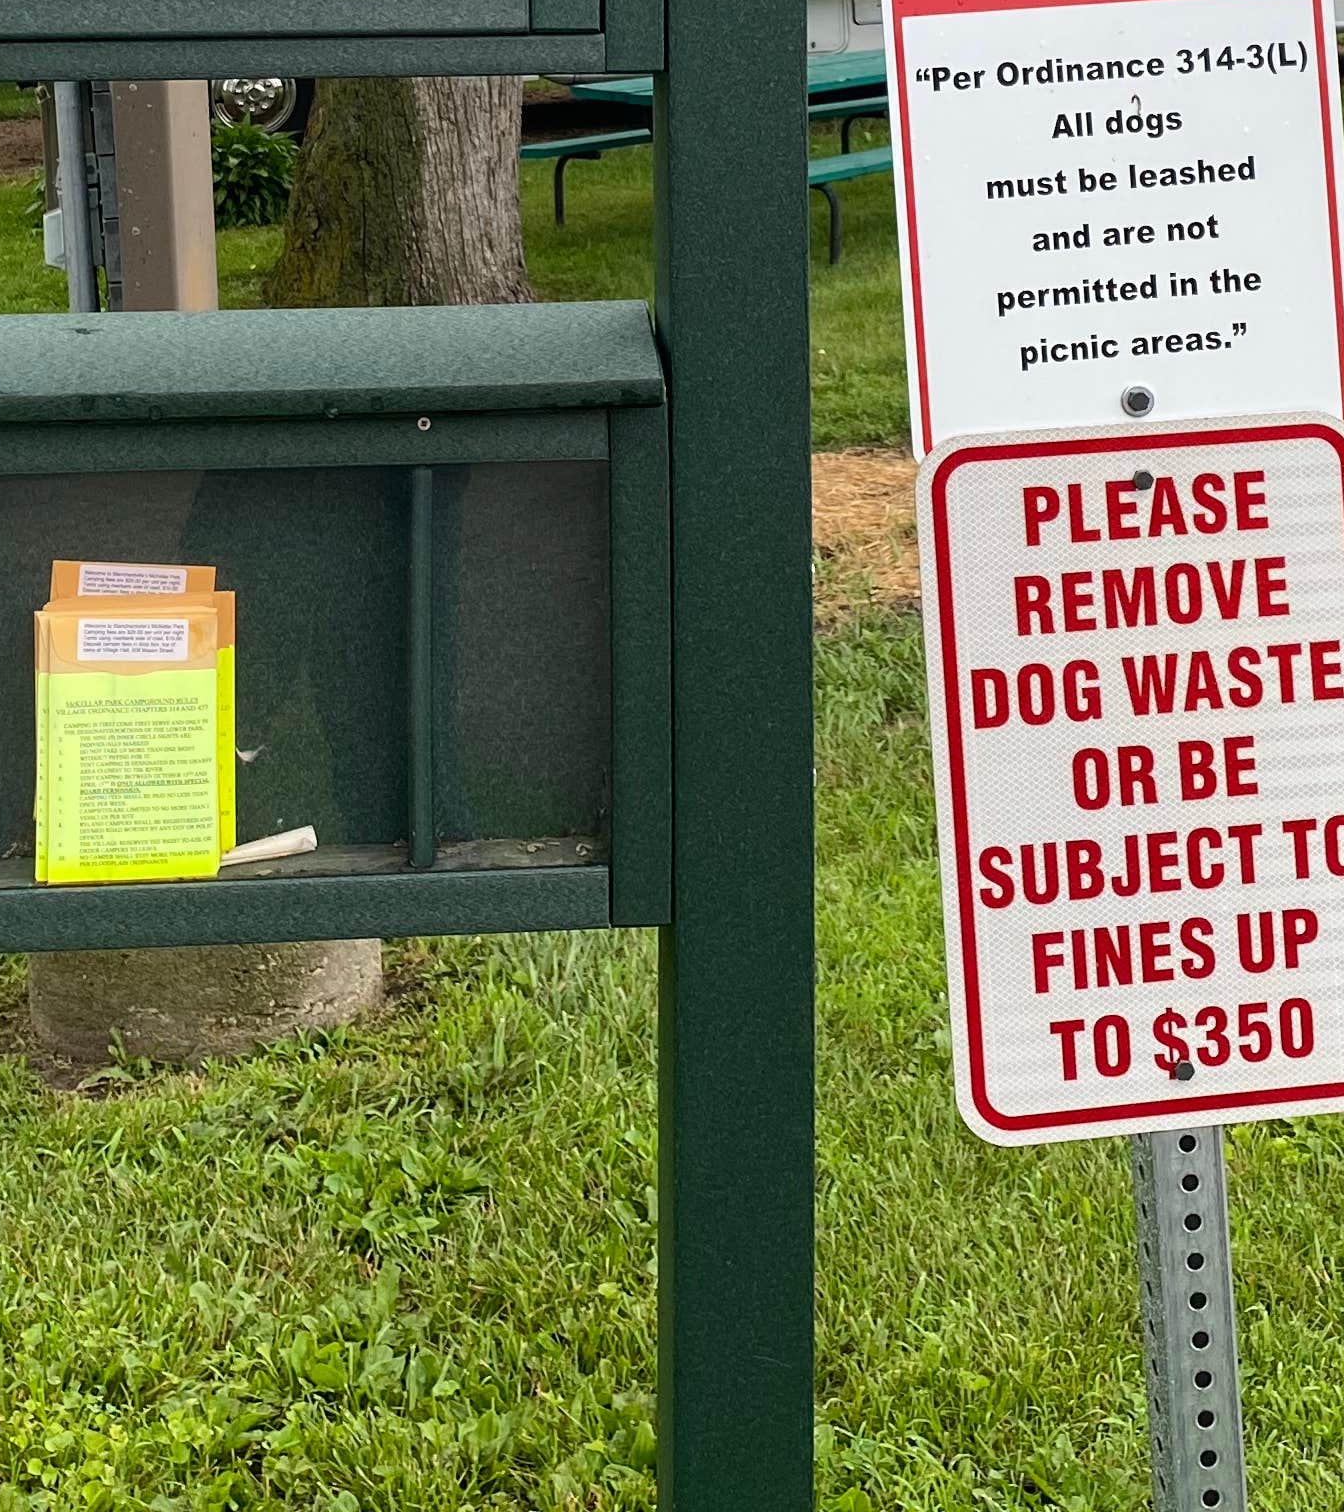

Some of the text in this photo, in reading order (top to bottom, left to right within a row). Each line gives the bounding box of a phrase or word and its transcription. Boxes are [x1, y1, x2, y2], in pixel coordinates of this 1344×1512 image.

[916, 41, 1309, 92] “Per Ordinance 314-3(L)
[1052, 106, 1182, 139] All dogs
[986, 156, 1256, 200] must be leashed
[1032, 216, 1220, 252] and are not
[996, 268, 1262, 317] permitted in the
[1020, 322, 1248, 372] picnic areas.”
[1023, 469, 1268, 547] PLEASE
[1014, 557, 1290, 636] REMOVE
[972, 640, 1344, 730] DOG WASTE
[1072, 736, 1259, 810] OR BE
[979, 825, 1263, 909] SUBJECT
[1032, 909, 1318, 994] FINES UP
[1050, 997, 1315, 1080] TO $350
